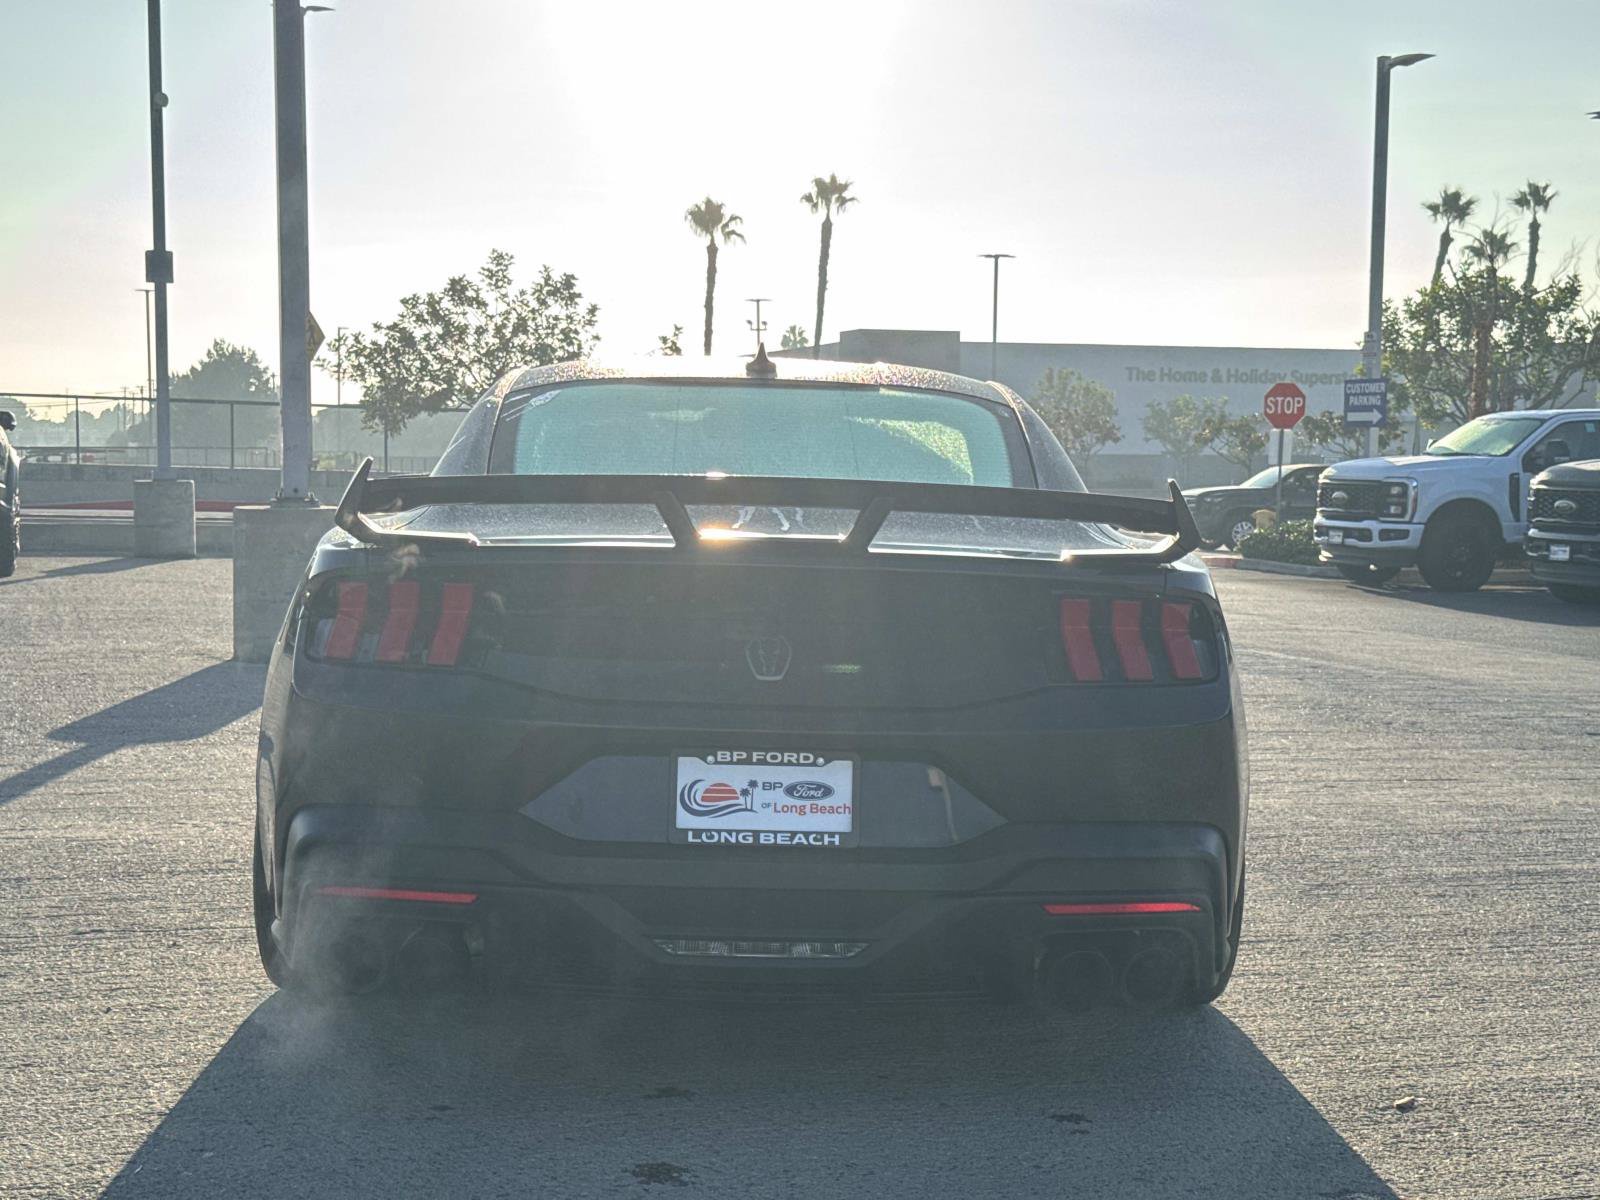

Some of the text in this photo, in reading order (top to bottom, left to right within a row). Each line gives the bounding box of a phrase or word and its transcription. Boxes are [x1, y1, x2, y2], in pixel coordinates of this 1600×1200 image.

[1125, 366, 1156, 383] The
[1159, 367, 1205, 384] Home
[1209, 368, 1223, 384] &
[1226, 368, 1287, 388] Holiday
[1345, 381, 1386, 394] CUSTOMER
[1265, 396, 1304, 415] STOP
[1348, 393, 1381, 406] PARKING
[716, 750, 814, 764] BP FORD
[761, 781, 825, 799] BP Ford
[773, 802, 806, 816] Long
[809, 803, 852, 815] Beach
[687, 831, 840, 846] LONG BEACH
